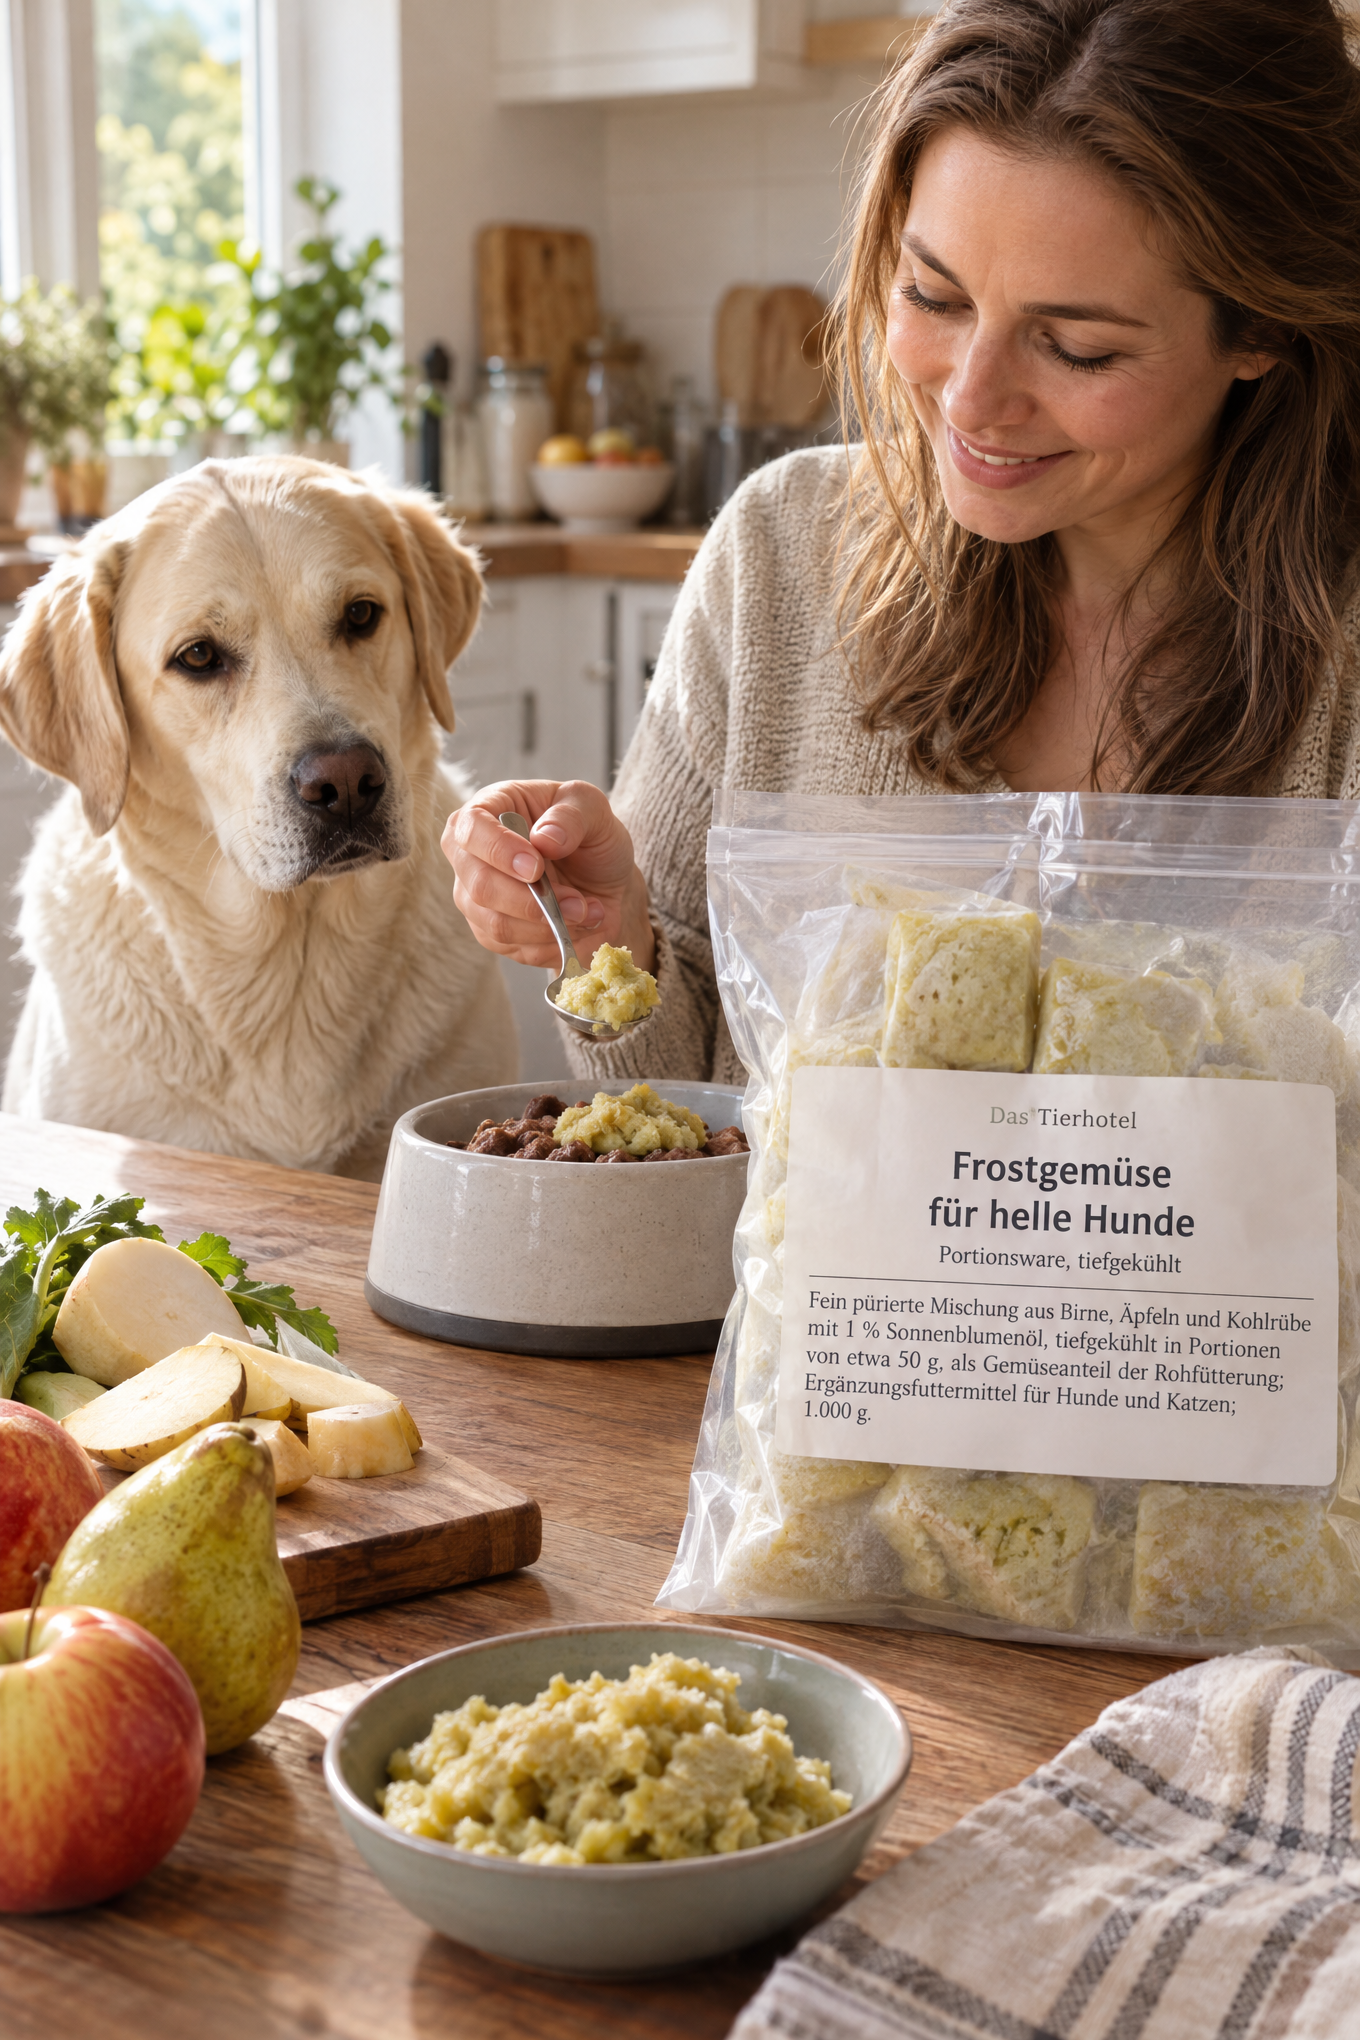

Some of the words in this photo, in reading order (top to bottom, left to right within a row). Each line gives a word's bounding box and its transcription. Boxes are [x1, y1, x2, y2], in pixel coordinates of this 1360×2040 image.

[990, 1107, 1028, 1125] Das
[1038, 1108, 1136, 1129] Tierhotel
[954, 1151, 1171, 1192] Frostgemüse
[929, 1196, 978, 1227] für
[990, 1199, 1071, 1232] helle
[1084, 1204, 1194, 1237] Hunde
[939, 1246, 1070, 1271] Portionsware,
[1078, 1252, 1181, 1276] tiefgekühlt
[809, 1291, 846, 1309] Fein
[853, 1295, 924, 1315] pürierte
[930, 1297, 1019, 1323] Mischung
[1025, 1306, 1054, 1319] aus
[1060, 1303, 1113, 1325] Birne,
[1119, 1303, 1179, 1329] Äpfeln
[1186, 1310, 1220, 1327] und
[1227, 1311, 1311, 1332] Kohlrübe
[808, 1320, 838, 1337] mit
[847, 1320, 854, 1337] 1
[863, 1321, 880, 1338] %
[887, 1322, 1047, 1350] Sonnenblumenöl,
[1056, 1331, 1157, 1355] tiefgekühlt
[1164, 1336, 1181, 1354] in
[1189, 1337, 1280, 1359] Portionen
[806, 1351, 839, 1364] von
[847, 1351, 890, 1367] etwa
[898, 1351, 921, 1368] 50
[928, 1357, 943, 1375] g,
[951, 1353, 976, 1372] als
[984, 1355, 1111, 1378] Gemüseanteil
[1118, 1361, 1148, 1380] der
[1155, 1364, 1283, 1392] Rohfütterung;
[805, 1373, 1016, 1402] Ergänzungsfuttermittel
[1023, 1385, 1050, 1403] für
[1057, 1387, 1118, 1407] Hunde
[1125, 1391, 1160, 1409] und
[1167, 1393, 1235, 1416] Katzen;
[805, 1400, 851, 1419] 1.000
[857, 1408, 871, 1425] g.
